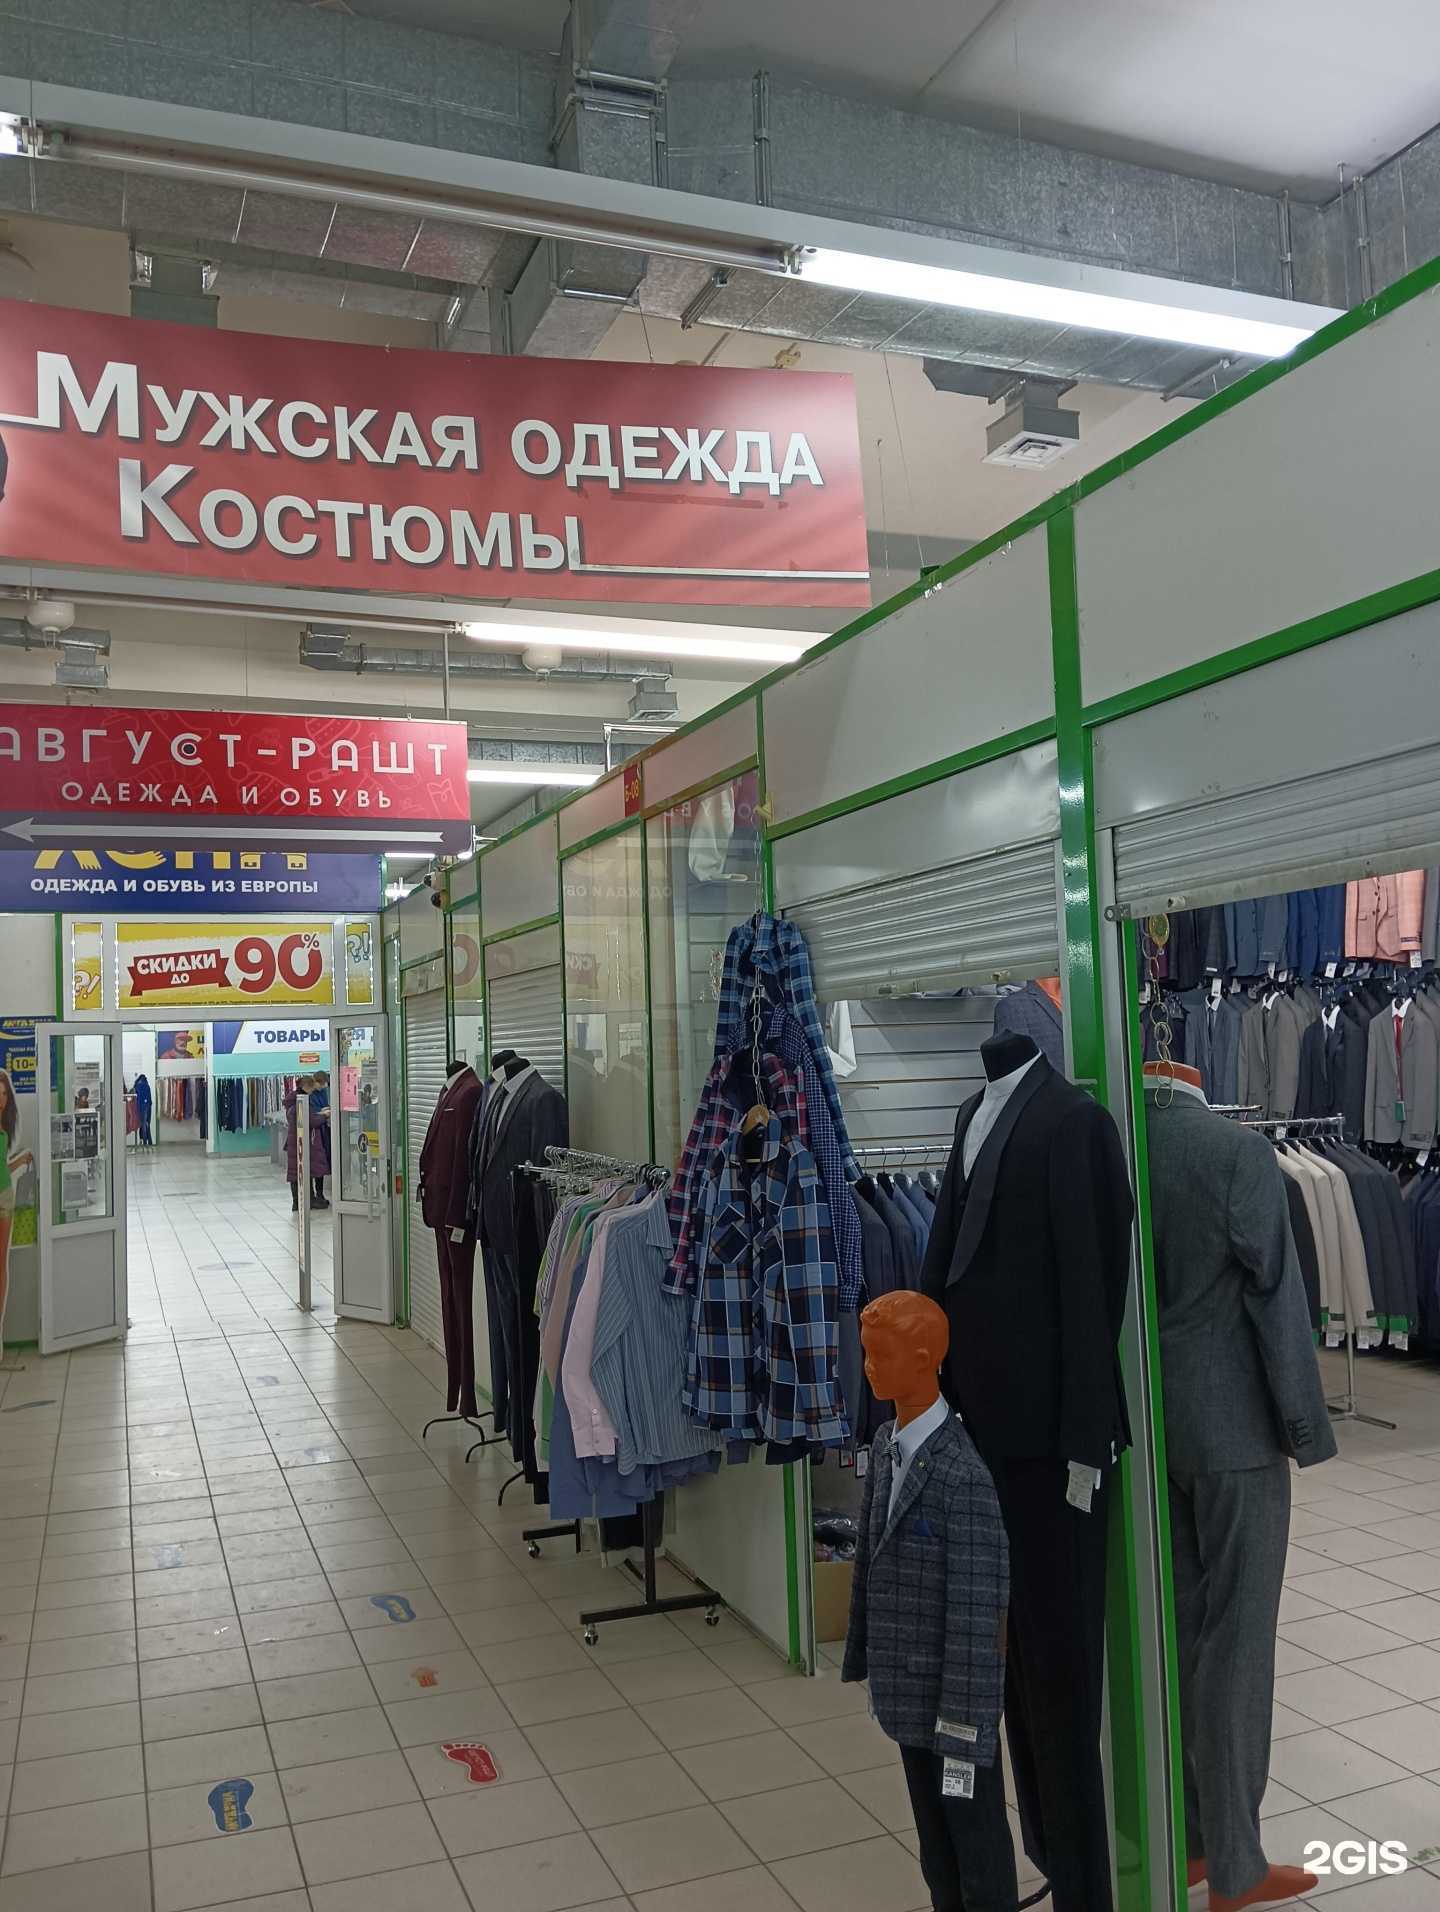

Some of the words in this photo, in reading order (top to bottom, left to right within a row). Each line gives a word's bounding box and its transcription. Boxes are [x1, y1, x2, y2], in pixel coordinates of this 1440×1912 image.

[511, 419, 824, 496] ОДЕЖДА
[62, 781, 218, 807] ОДЕЖДА
[241, 786, 259, 805] И
[280, 787, 392, 808] ОБУВЬ
[30, 878, 118, 894] ОДЕЖДА
[123, 880, 137, 892] И
[143, 879, 206, 893] ОБУВЬ
[211, 881, 236, 893] ИЗ
[241, 881, 318, 893] ЕВРОПЫ
[136, 952, 217, 975] СКИДКИ
[170, 973, 190, 985] ДО
[254, 1028, 326, 1044] ТОВАРЫ
